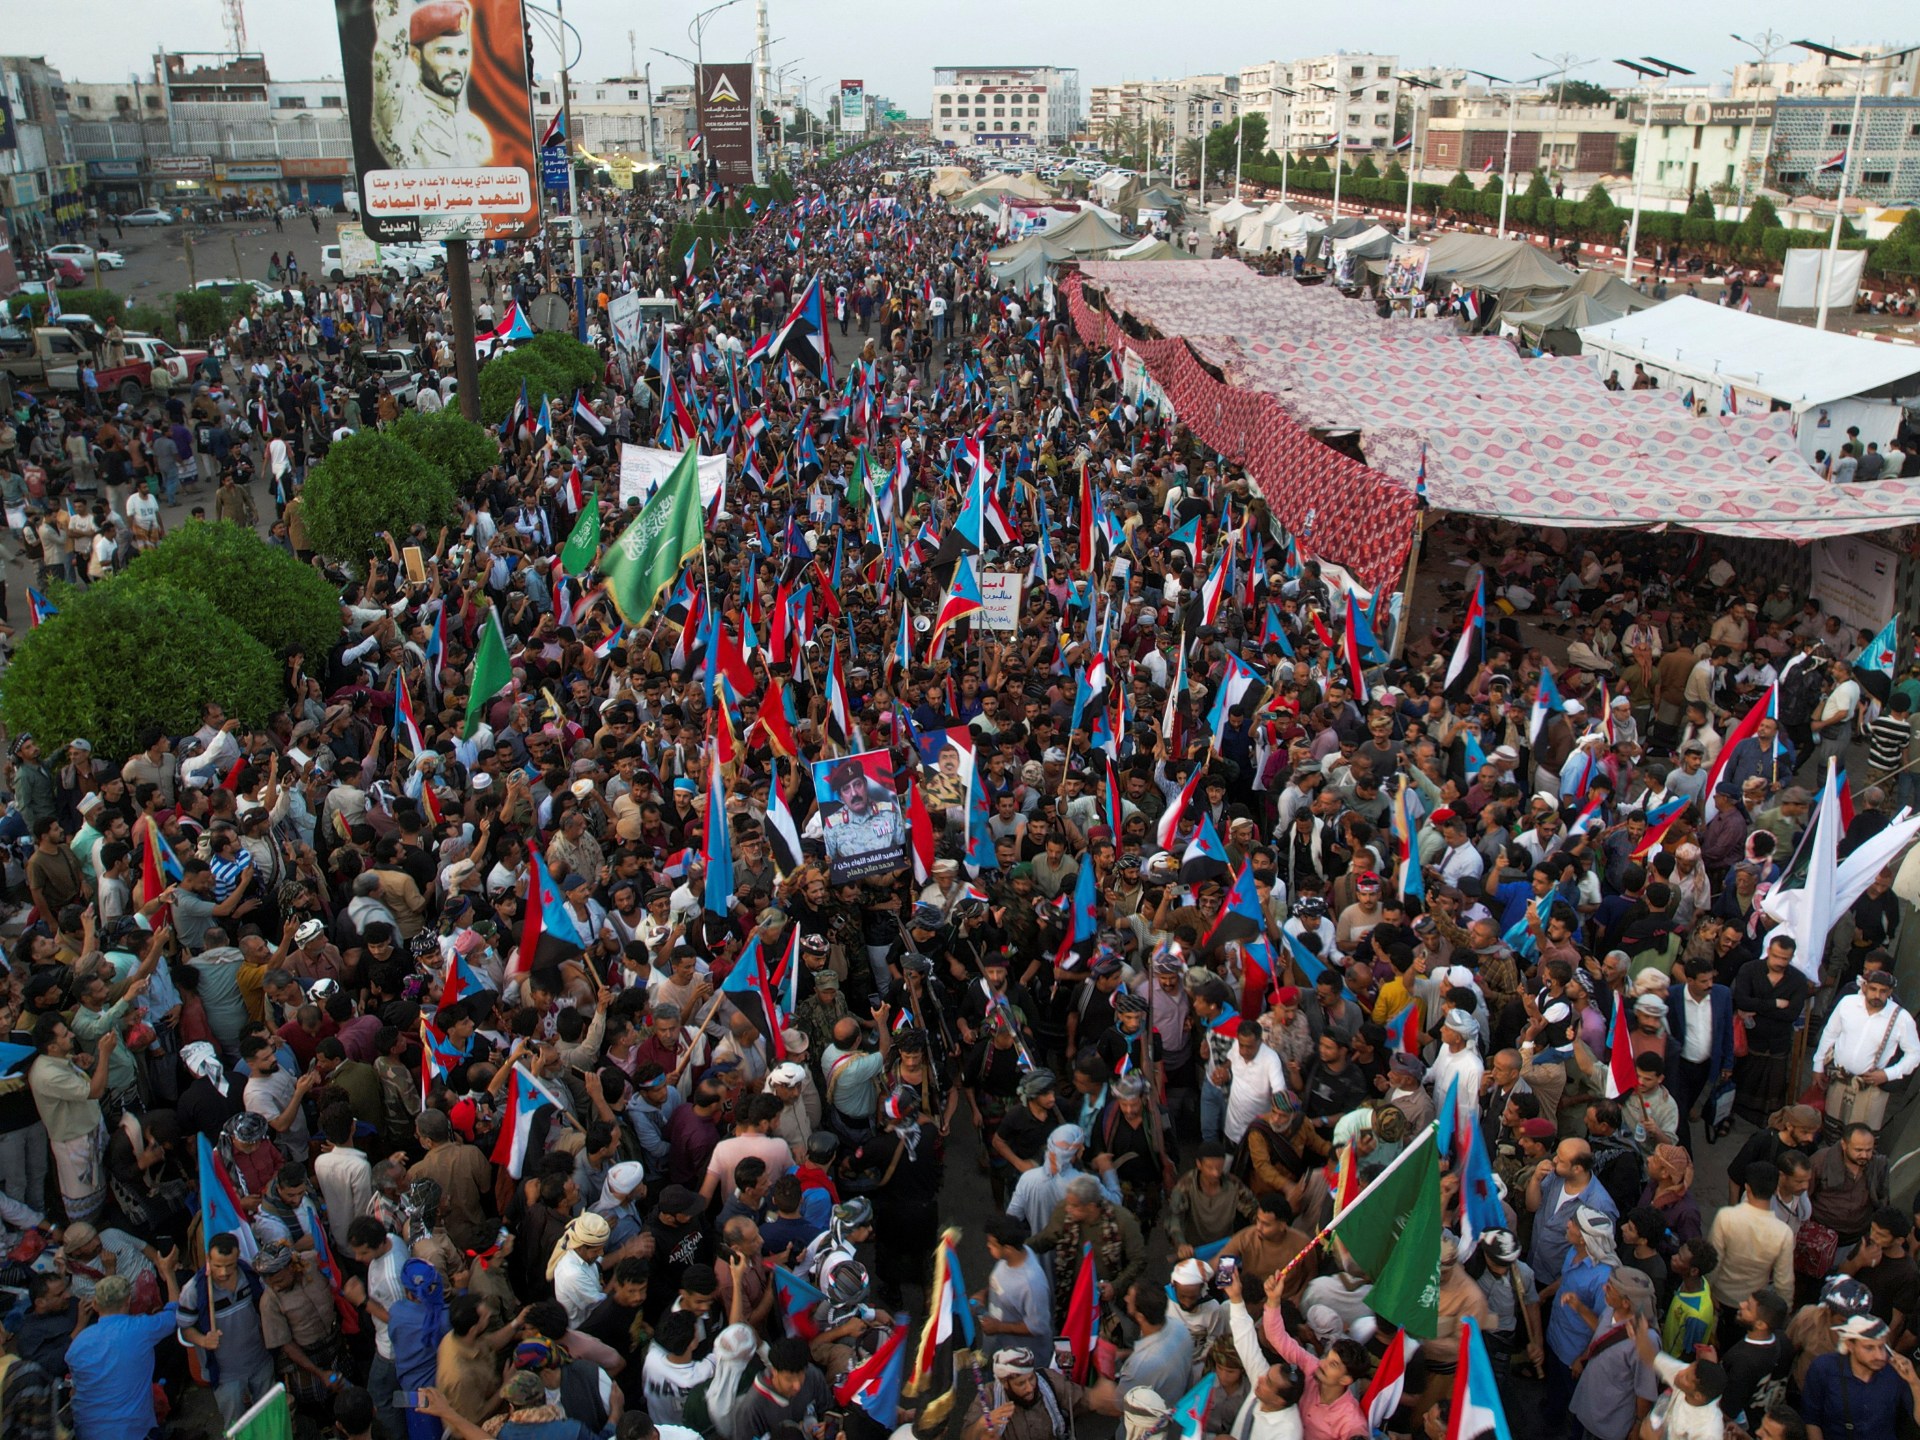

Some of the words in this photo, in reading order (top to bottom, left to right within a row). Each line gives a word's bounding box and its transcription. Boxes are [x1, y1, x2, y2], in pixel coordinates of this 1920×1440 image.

[394, 181, 399, 189] و
[451, 177, 474, 188] يهابه
[475, 175, 494, 188] الذي
[496, 174, 521, 184] القائد
[372, 194, 421, 211] اليمامة
[424, 189, 442, 210] أبو
[444, 193, 473, 210] منير
[478, 191, 524, 208] الشهيد
[379, 220, 417, 236] الحديث
[418, 218, 458, 237] الجنوبي
[460, 216, 493, 234] الجيش
[495, 218, 525, 232] مؤسس
[866, 853, 882, 862] القائد
[883, 849, 904, 860] الشهيد
[851, 857, 867, 866] اللواء
[879, 861, 895, 870] محمد
[846, 868, 864, 878] طماح
[864, 865, 878, 874] صالح
